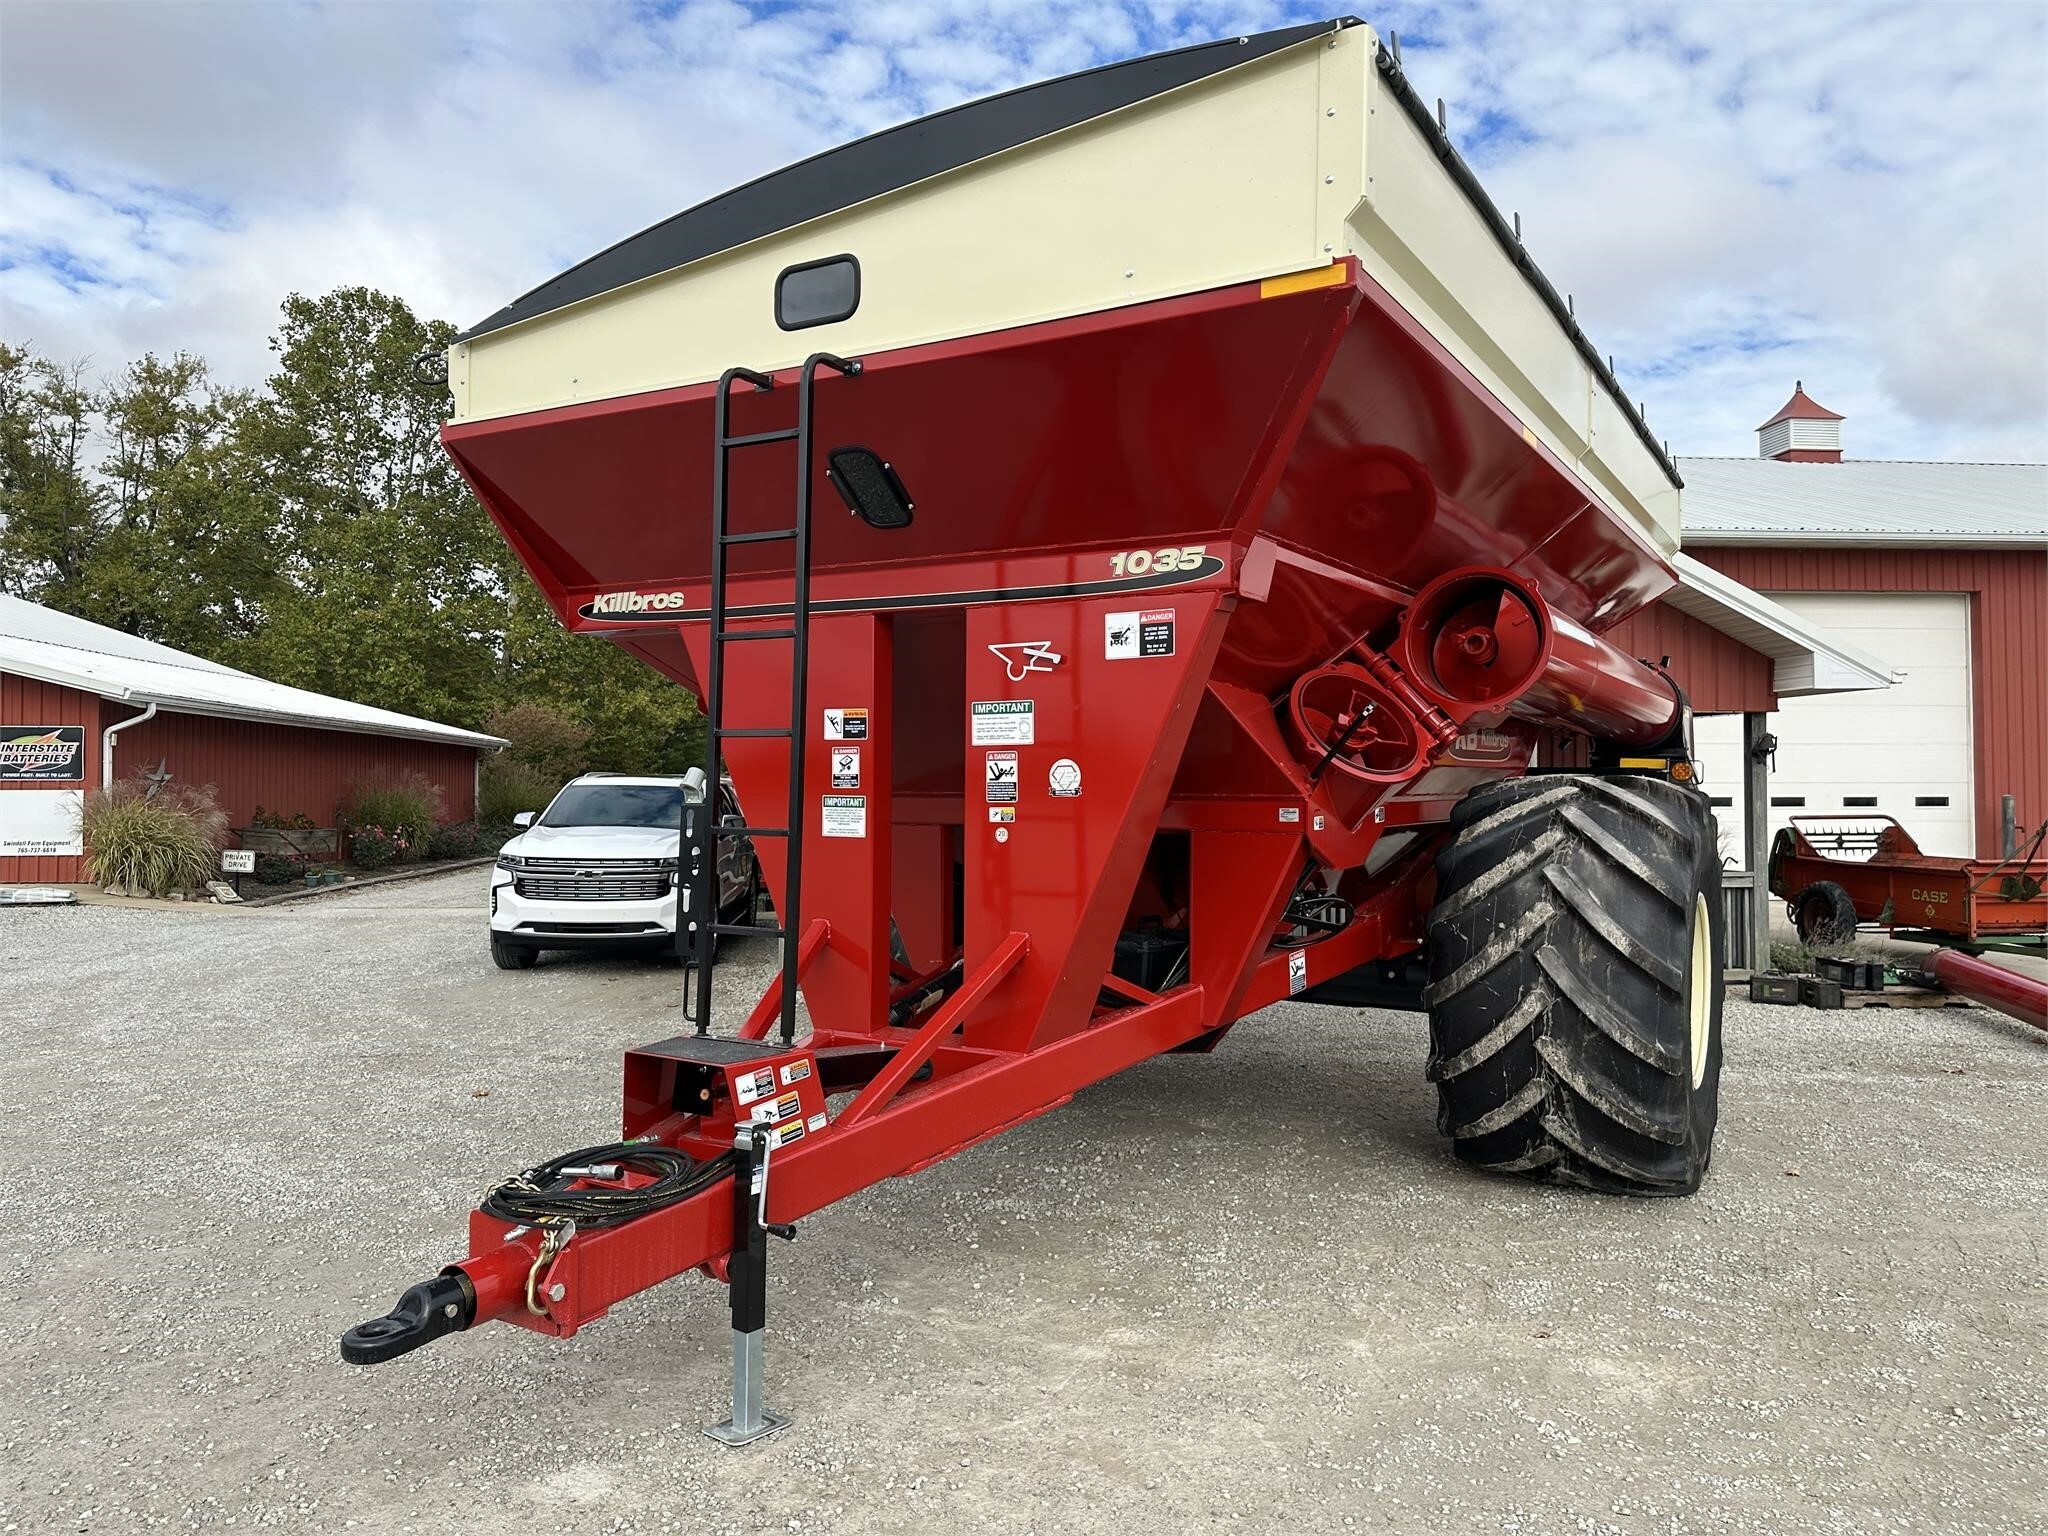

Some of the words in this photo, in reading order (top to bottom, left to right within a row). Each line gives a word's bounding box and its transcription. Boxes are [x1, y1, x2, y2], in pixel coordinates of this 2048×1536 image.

[1109, 546, 1206, 577] 1035
[593, 591, 685, 613] Killbros
[1147, 613, 1173, 621] DANGER
[975, 703, 1031, 713] IMPORTANT
[1, 744, 75, 753] INTERSTATE
[3, 754, 69, 763] BATTERIES
[825, 797, 864, 807] IMPORTANT
[224, 853, 252, 861] PRIVATE
[1911, 888, 1949, 903] CASE
